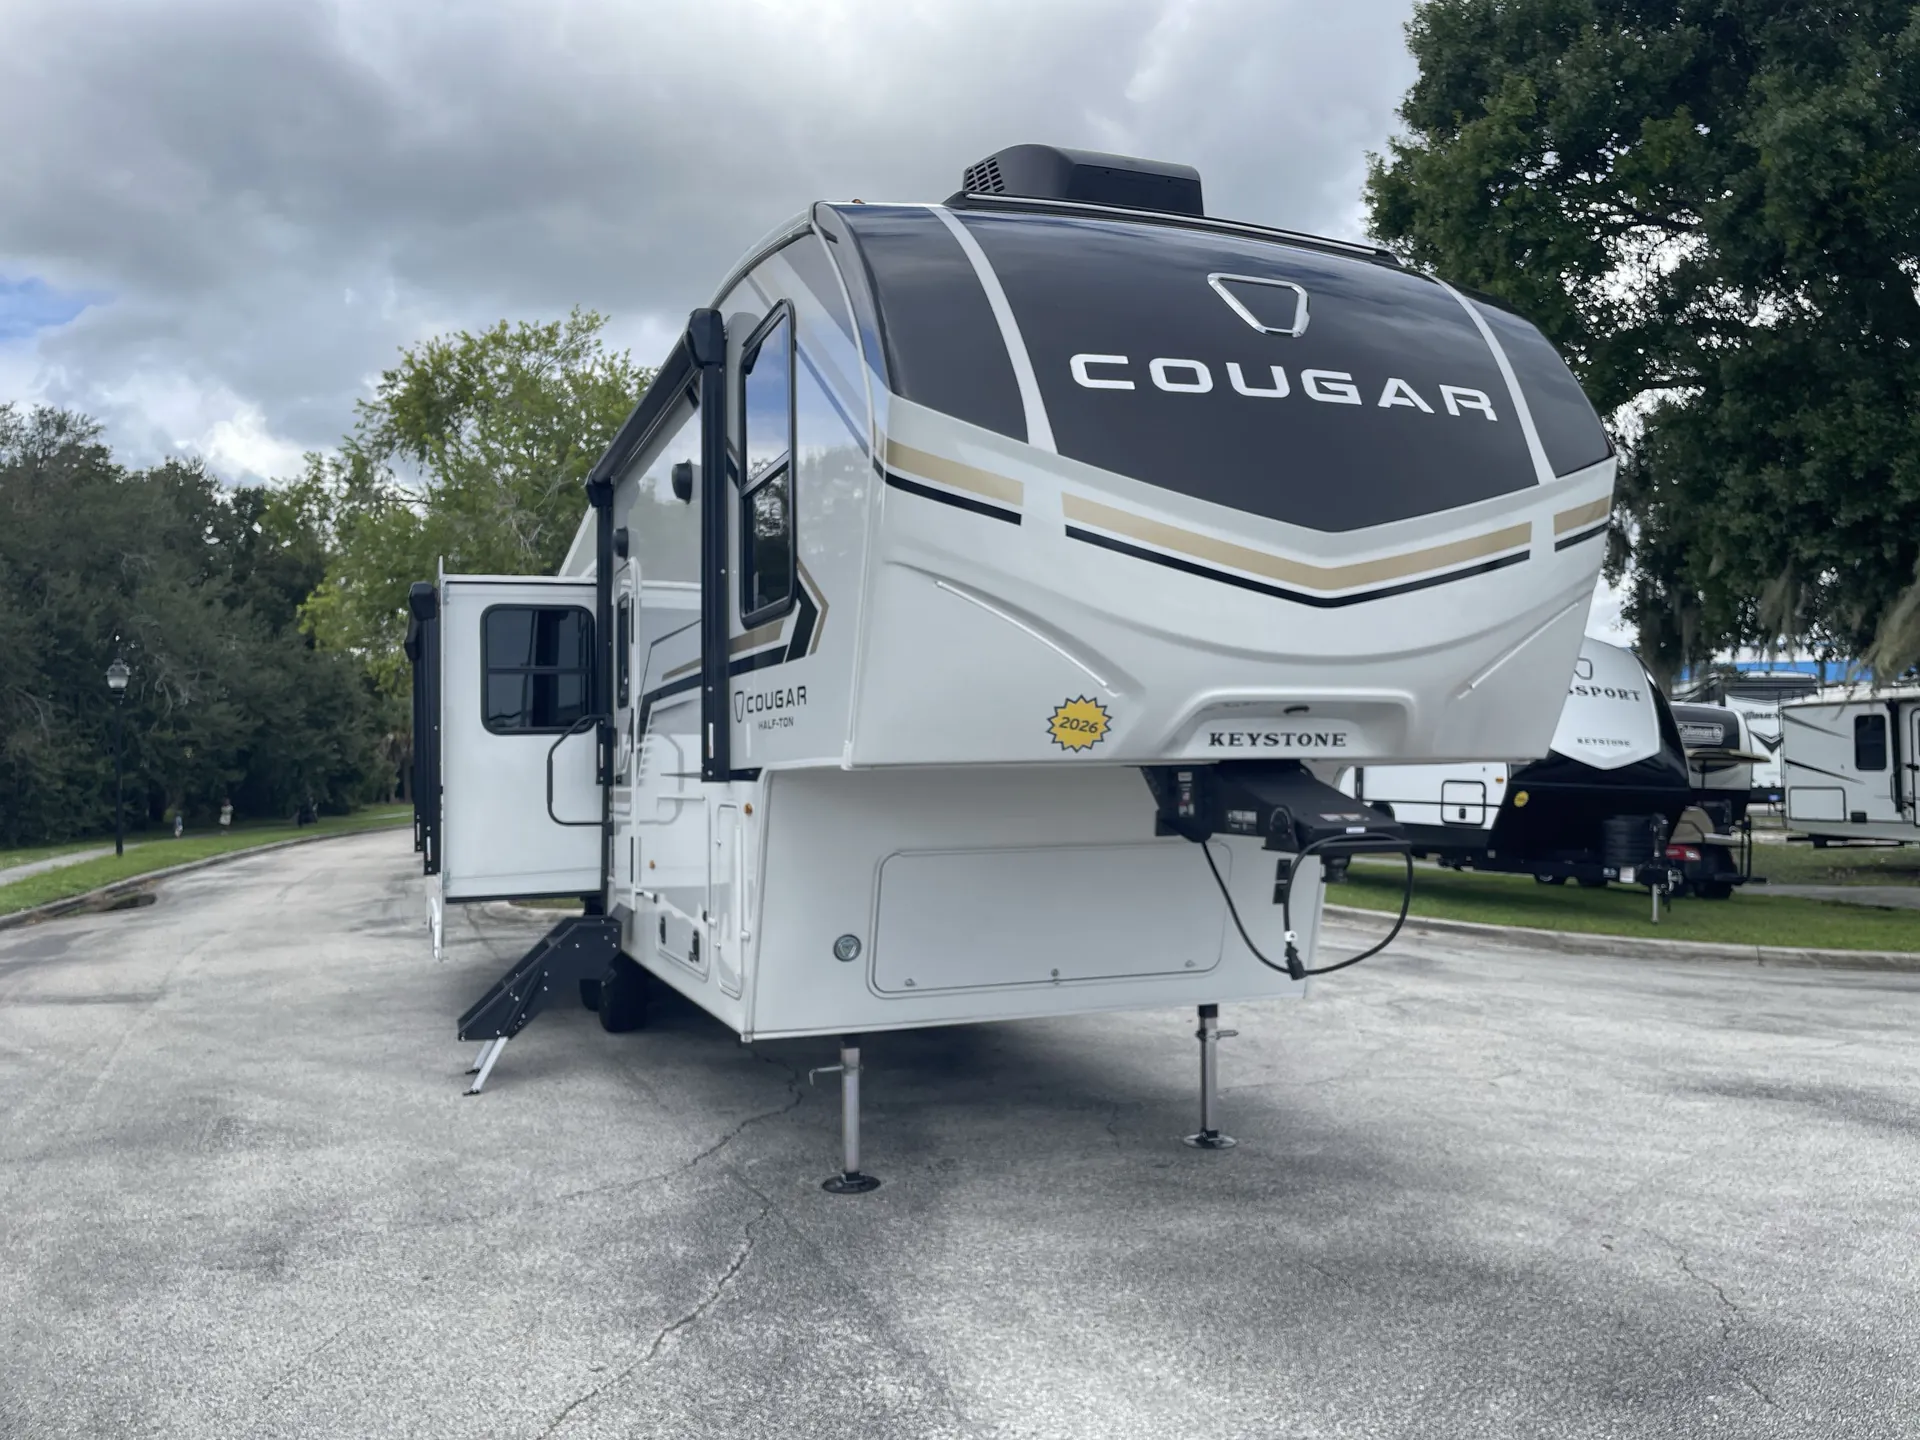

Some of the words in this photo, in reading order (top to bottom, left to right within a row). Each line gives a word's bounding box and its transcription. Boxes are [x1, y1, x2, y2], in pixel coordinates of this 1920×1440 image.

[1069, 353, 1498, 421] COUGAR
[746, 685, 807, 714] COUGAR
[758, 716, 794, 730] HALF-TON
[1059, 716, 1099, 734] 2026
[1208, 732, 1347, 747] KEYSTONE
